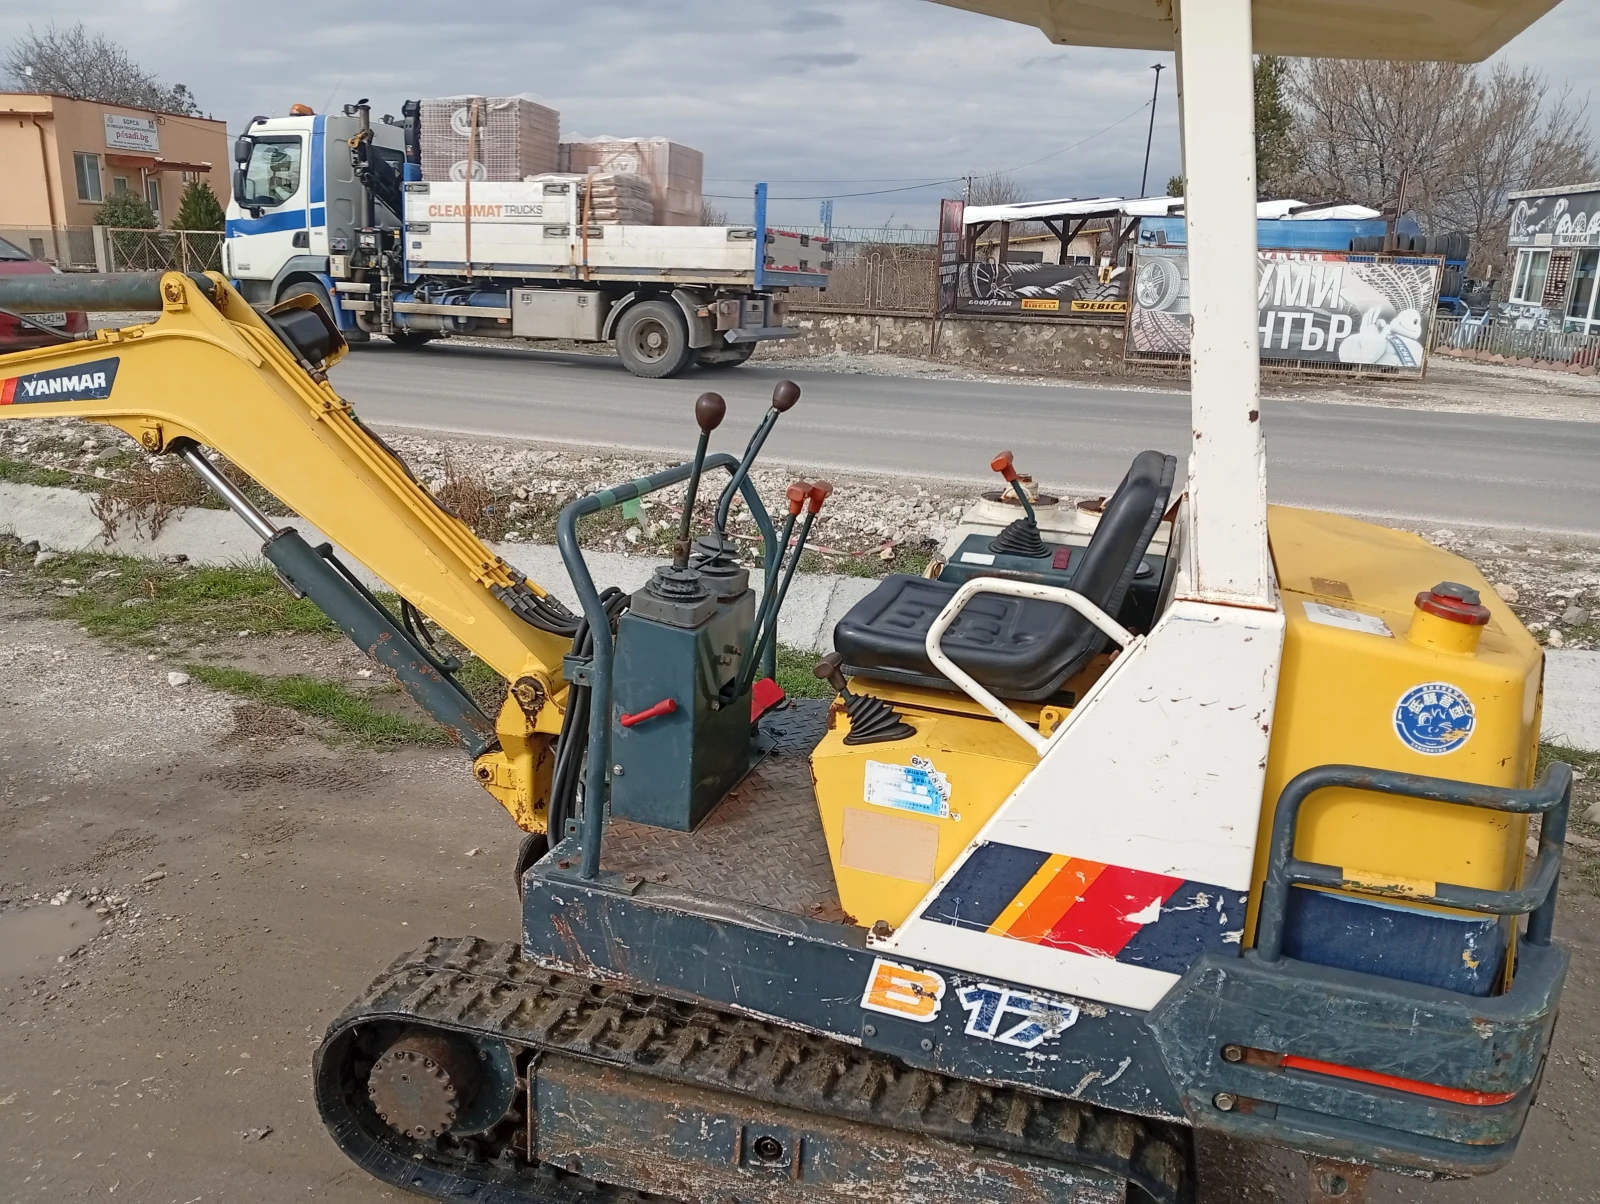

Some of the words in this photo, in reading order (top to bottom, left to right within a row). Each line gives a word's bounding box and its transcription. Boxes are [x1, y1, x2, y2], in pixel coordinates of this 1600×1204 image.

[504, 204, 543, 214] TRUCKS
[968, 298, 1012, 307] GOODYEAR
[1024, 300, 1056, 309] PIRELLI
[22, 372, 106, 396] YANMAR
